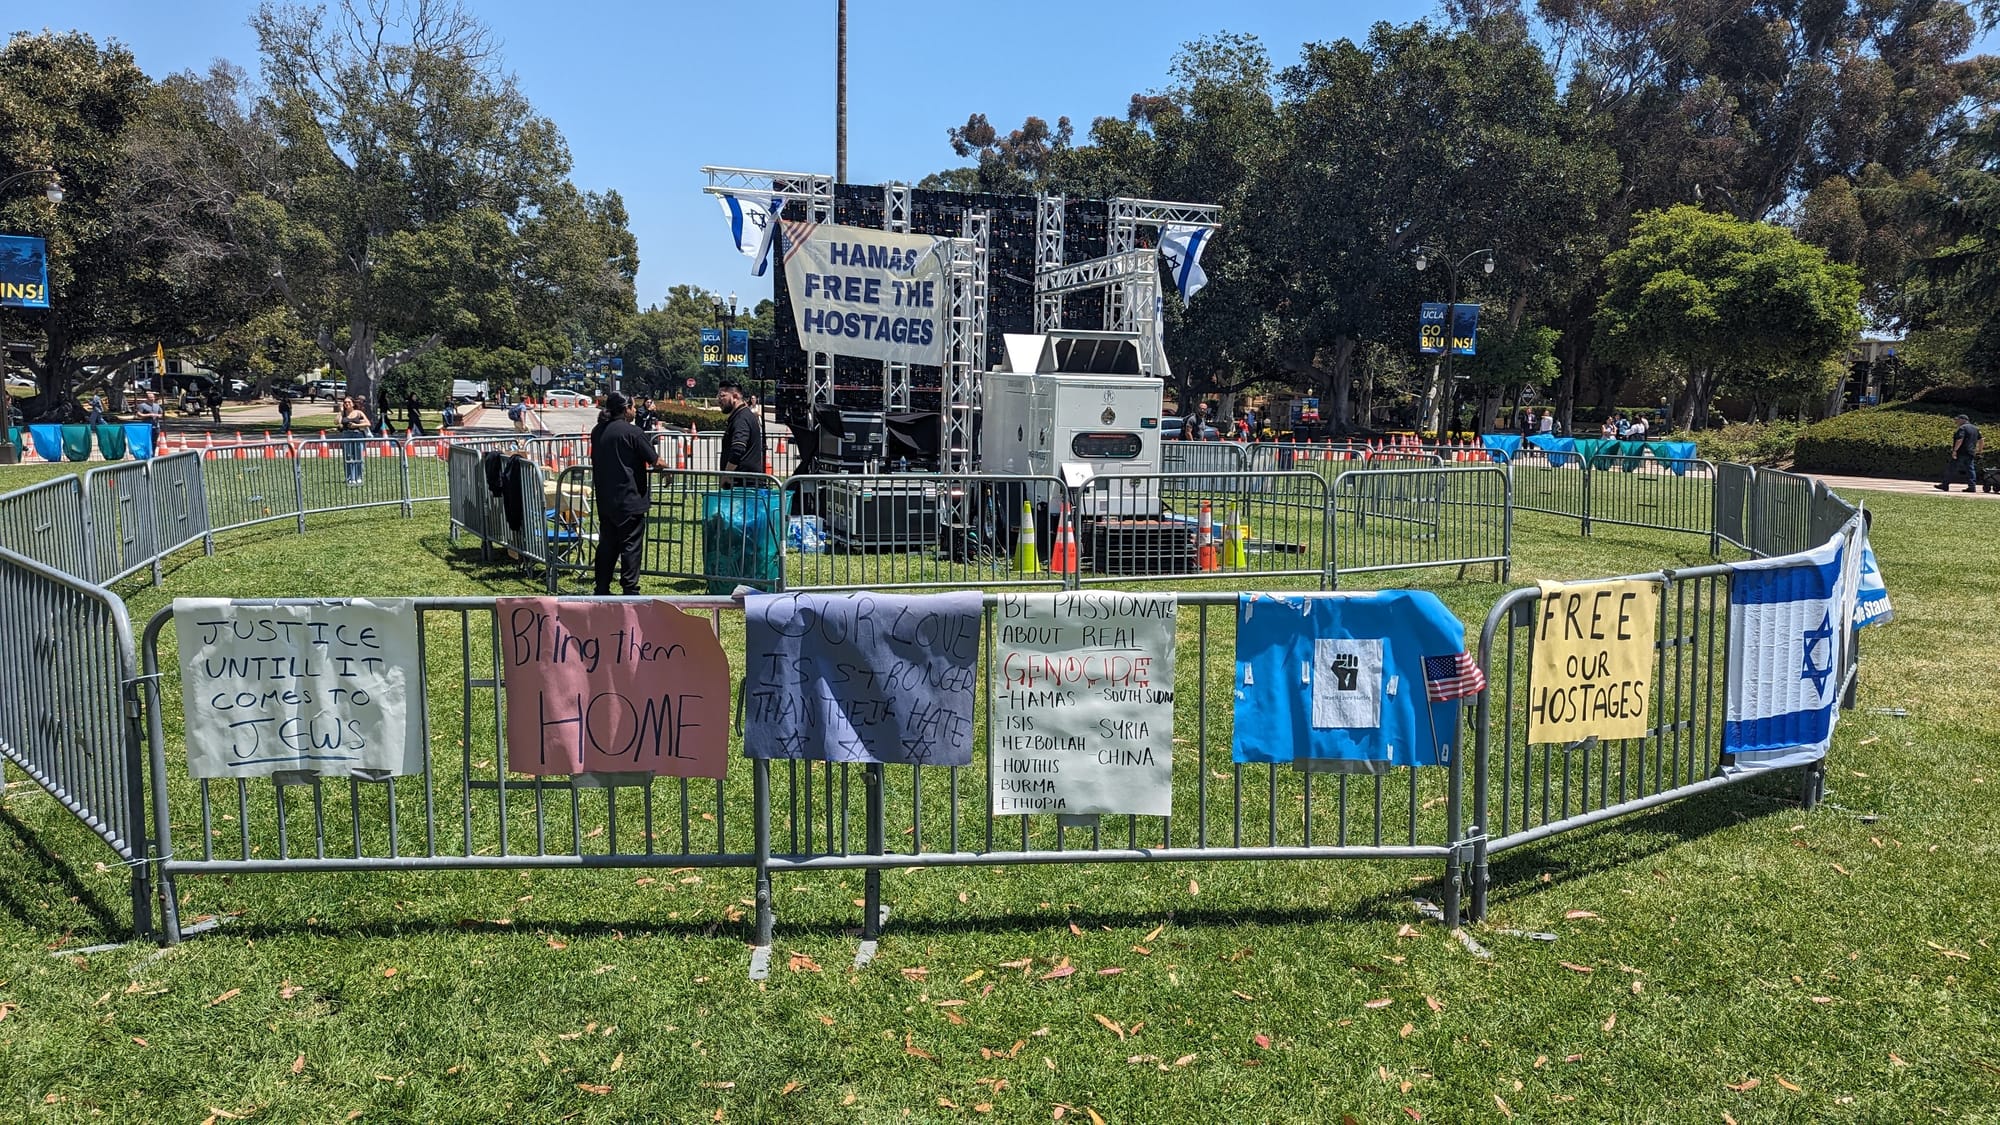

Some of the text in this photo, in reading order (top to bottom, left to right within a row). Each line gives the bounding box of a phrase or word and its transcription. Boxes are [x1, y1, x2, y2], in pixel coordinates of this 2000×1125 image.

[804, 273, 934, 307] FREE THE
[803, 308, 934, 346] HOSTAGES
[1421, 324, 1441, 337] GO
[1422, 310, 1444, 319] UCLA
[703, 344, 720, 354] GO
[1004, 593, 1176, 620] BE PASSIONATE
[1541, 591, 1636, 641] FREE
[197, 619, 380, 648] JUSTICE
[511, 607, 600, 673] Bring
[765, 592, 976, 660] OUR LOVE
[1002, 625, 1144, 648] ABOUT REAL
[206, 656, 383, 681] UNTILL IT
[760, 653, 974, 698] IS STRONGER
[1003, 652, 1153, 690] GENOCIDE
[1566, 650, 1611, 681] OUR
[211, 688, 371, 710] COMES TO
[1530, 680, 1645, 729] HOSTAGES
[228, 717, 367, 758] JEWS
[539, 690, 704, 765] HOME
[753, 691, 971, 748] THAN THEIR HATE
